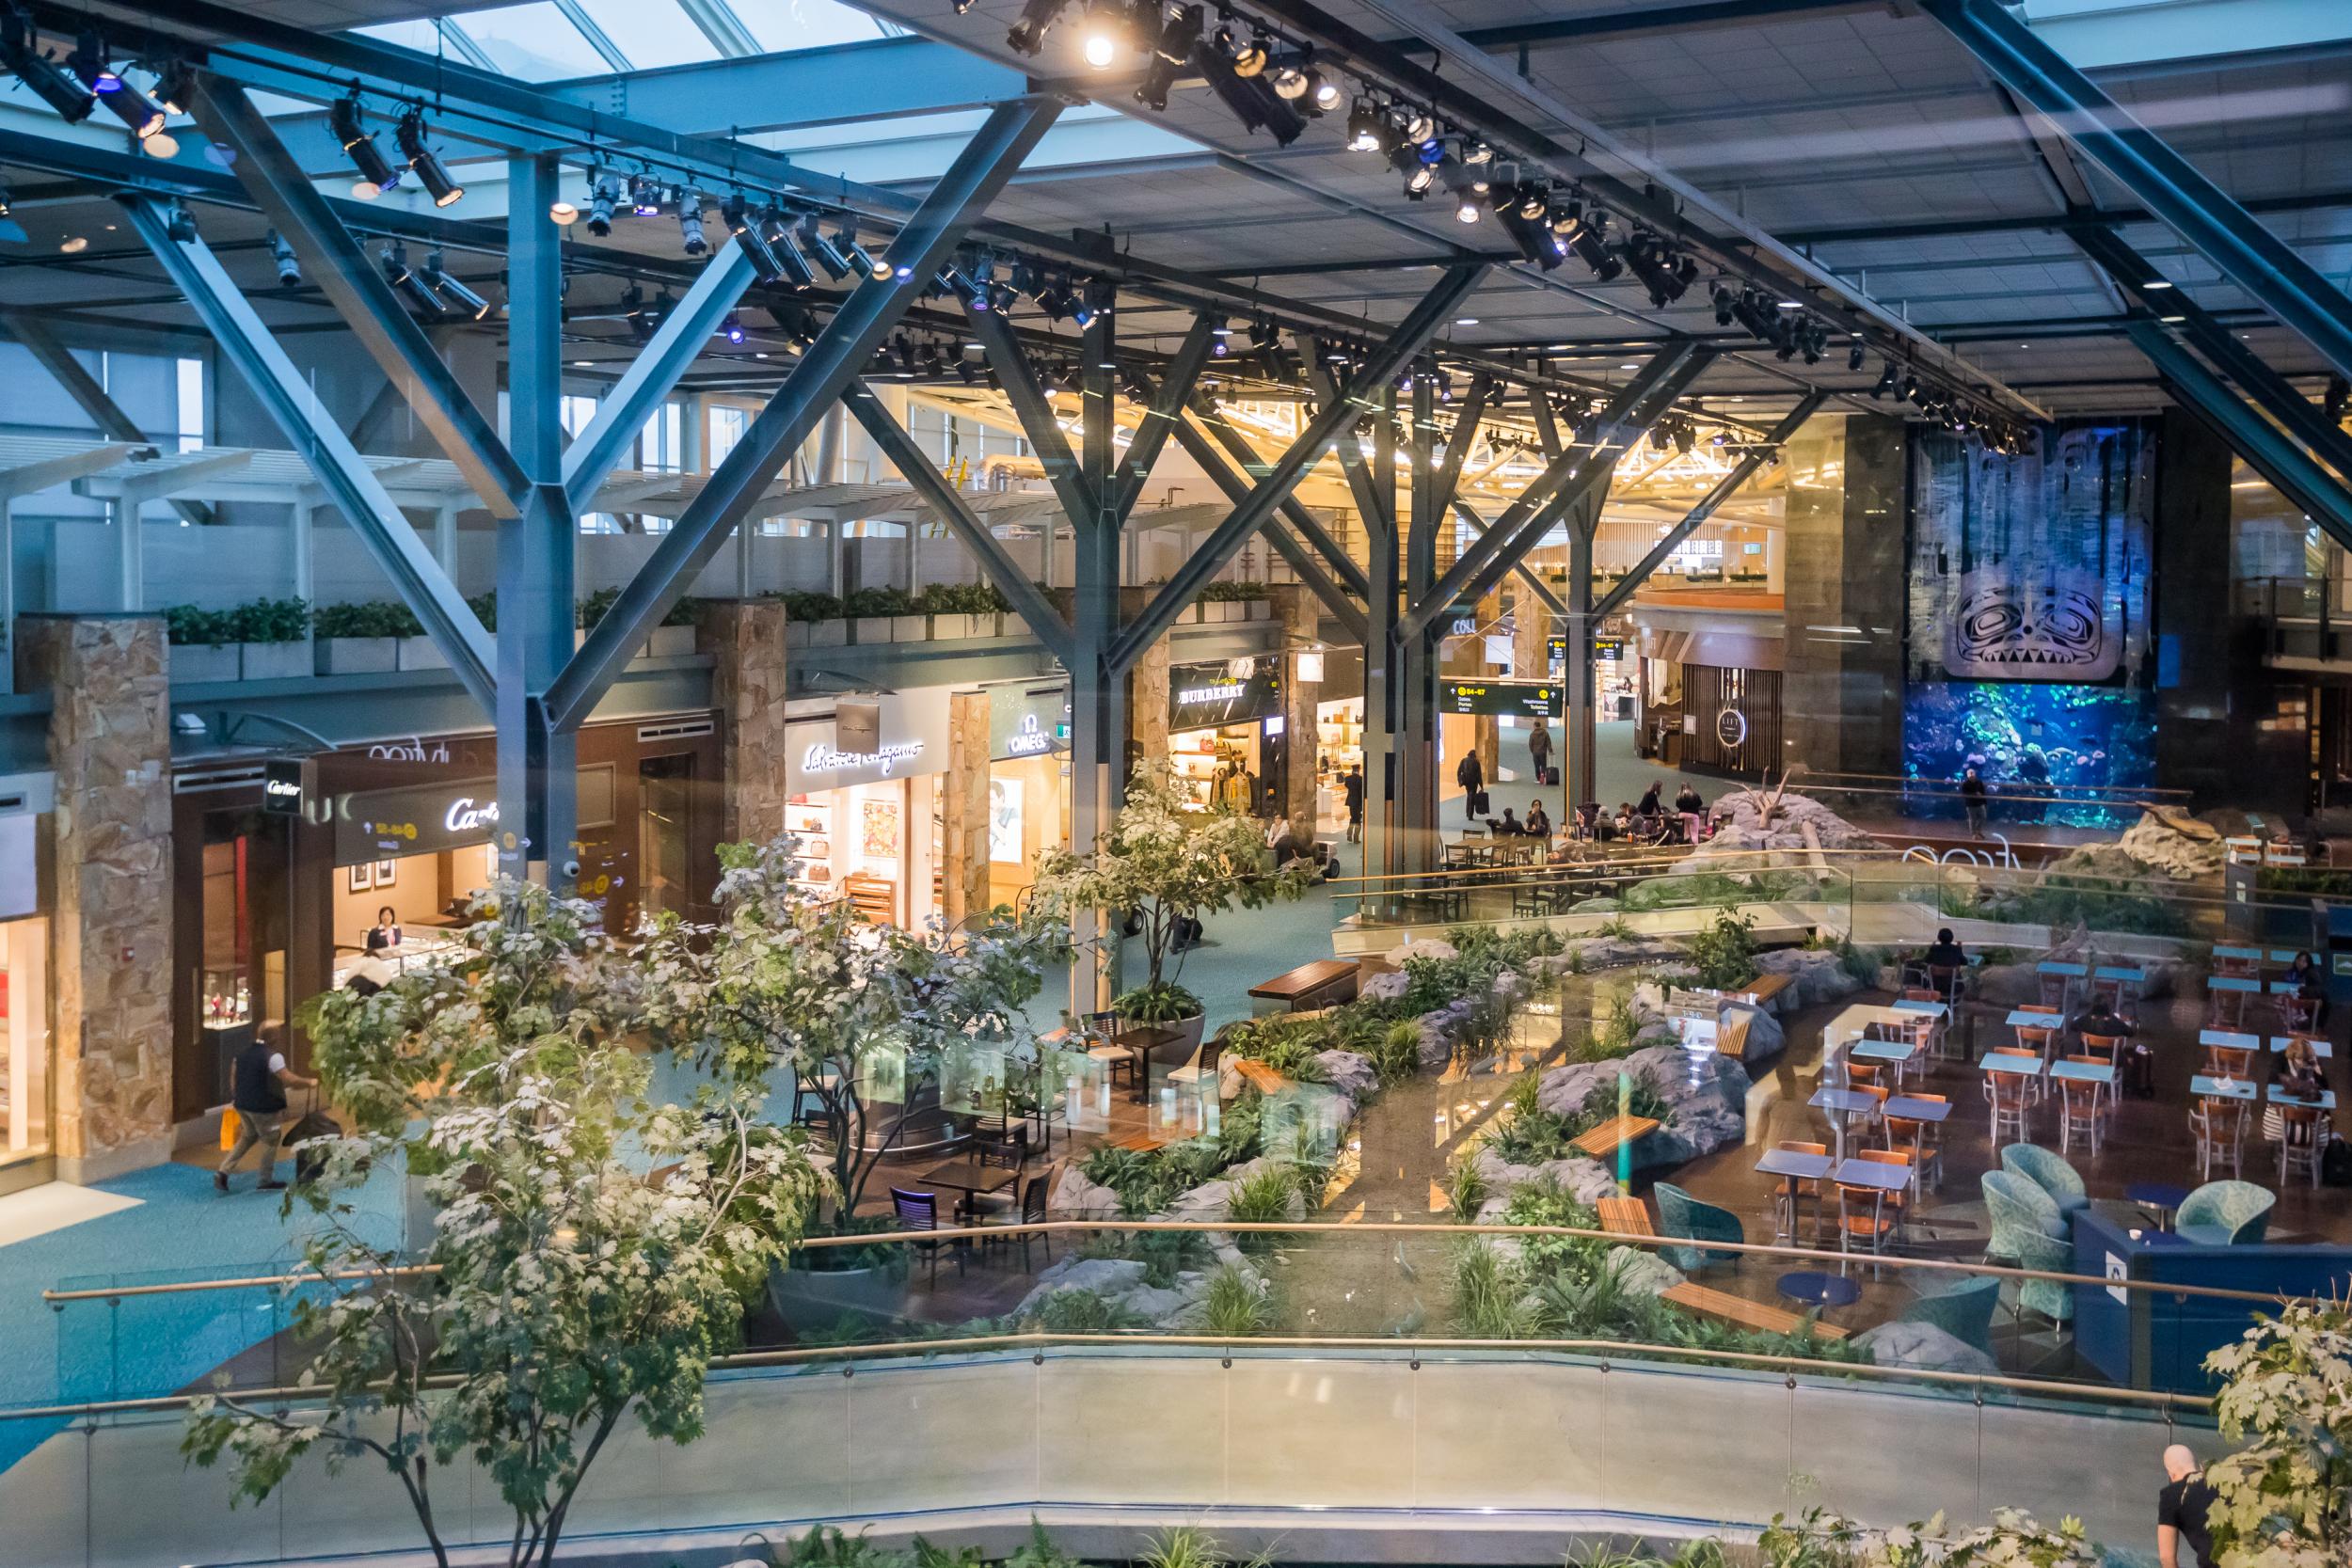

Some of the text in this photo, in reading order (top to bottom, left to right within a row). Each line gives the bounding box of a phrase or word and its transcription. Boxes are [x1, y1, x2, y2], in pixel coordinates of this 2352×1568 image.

[1179, 684, 1245, 705] BURBERRY
[1722, 717, 1739, 726] LIFT
[267, 779, 301, 796] Cartier
[445, 798, 500, 832] Cart
